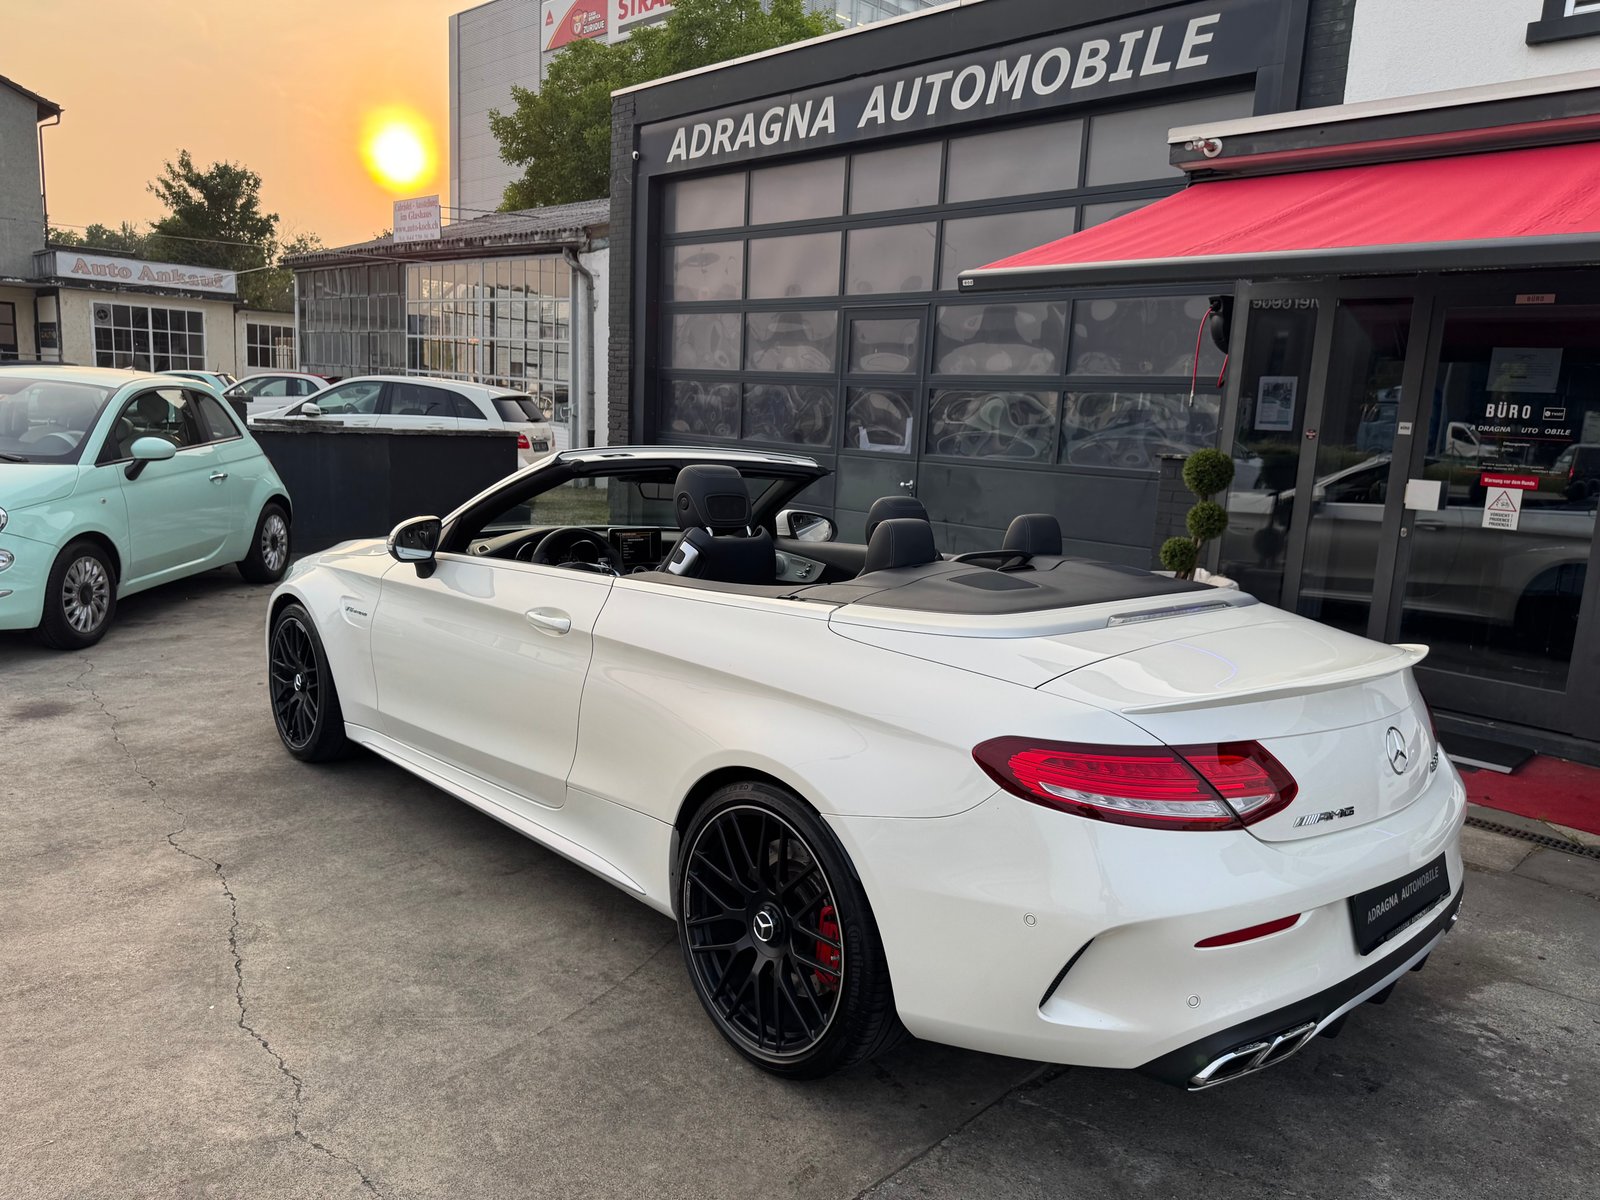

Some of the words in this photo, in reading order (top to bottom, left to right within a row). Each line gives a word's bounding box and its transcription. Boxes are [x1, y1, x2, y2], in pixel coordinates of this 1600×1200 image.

[666, 96, 835, 163] ADRAGNA
[857, 13, 1221, 128] AUTOMOBILE
[71, 257, 132, 280] Auto
[138, 265, 224, 289] Ankauf
[1485, 402, 1532, 419] BÜRO
[1367, 893, 1399, 925] ADRAGNA
[1401, 866, 1440, 901] AUTOMOBILE
